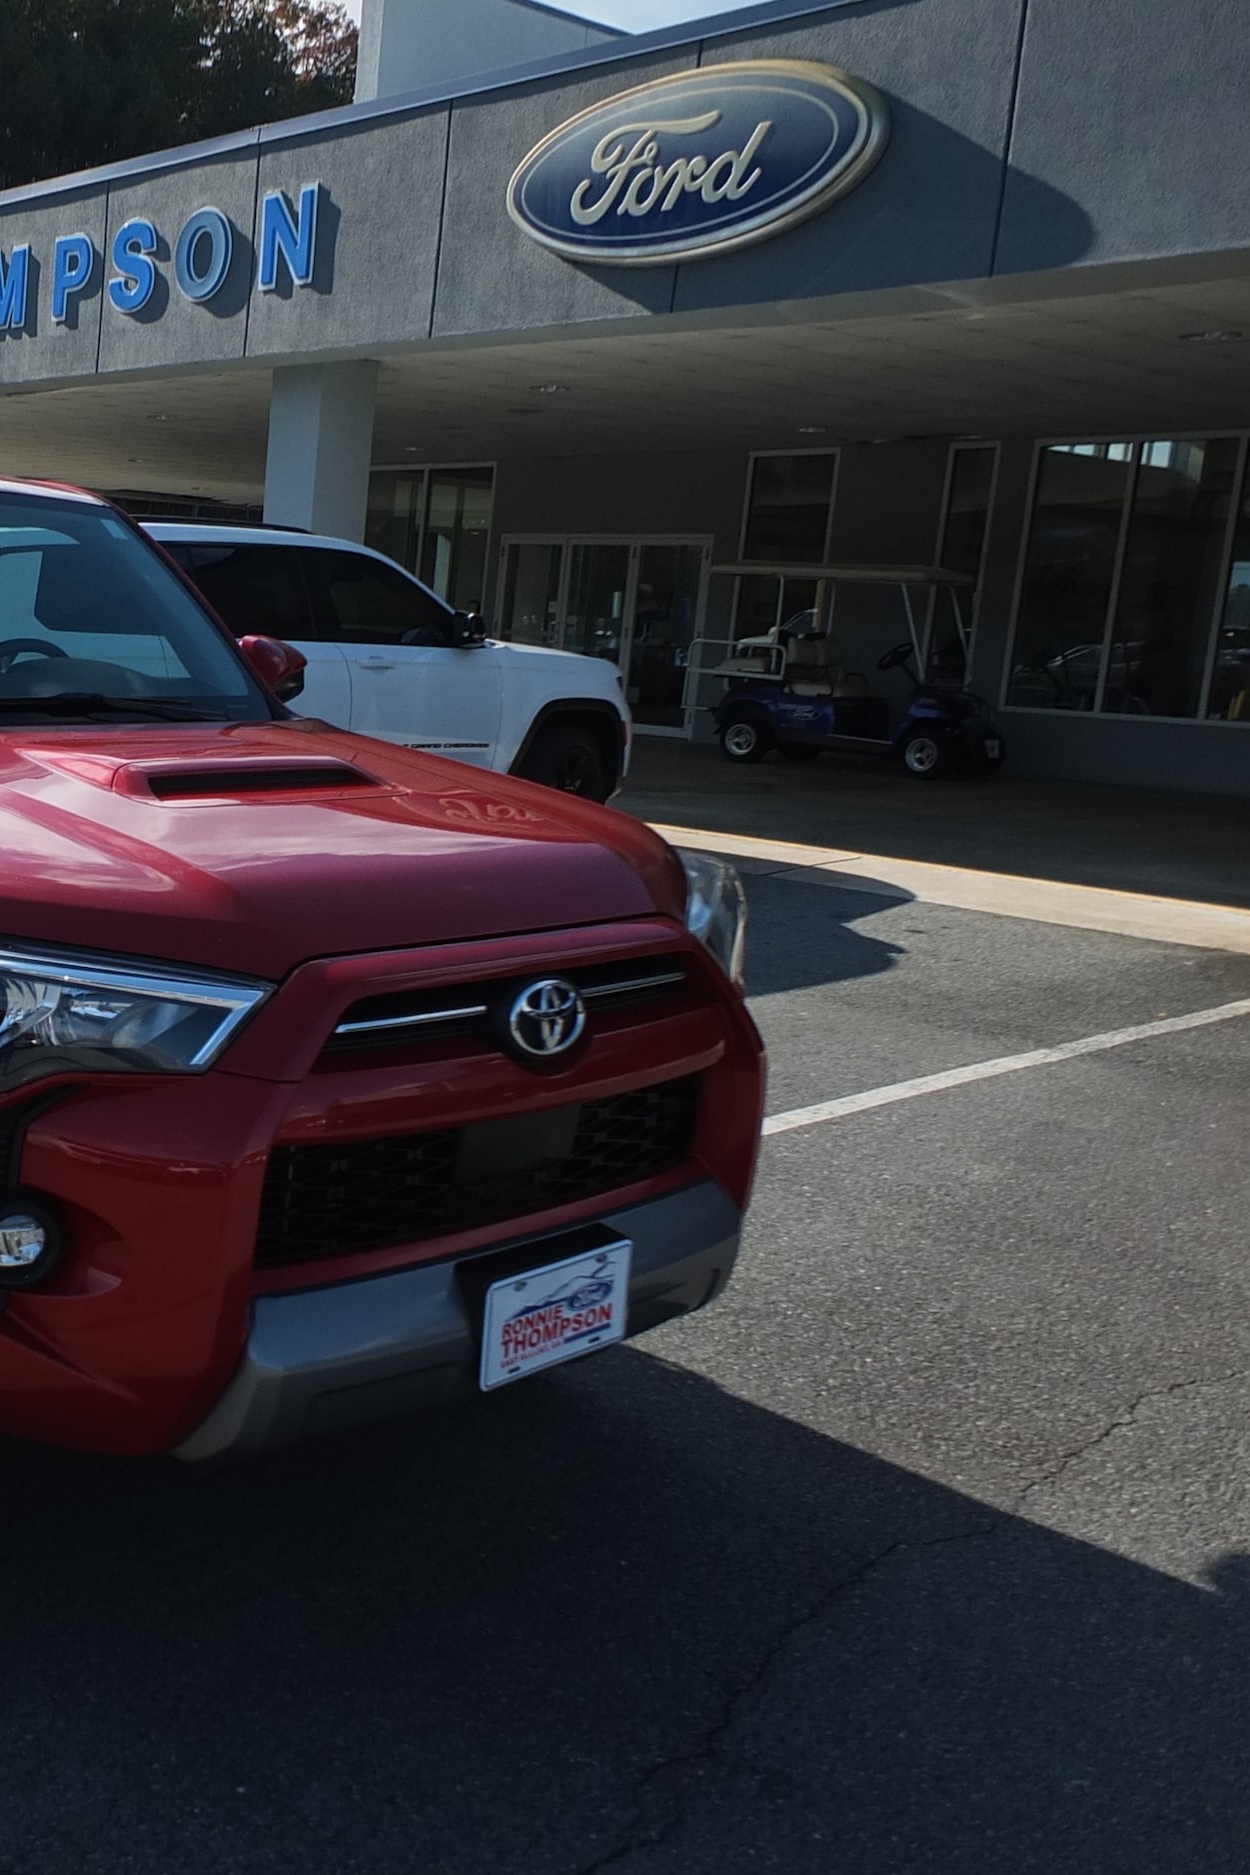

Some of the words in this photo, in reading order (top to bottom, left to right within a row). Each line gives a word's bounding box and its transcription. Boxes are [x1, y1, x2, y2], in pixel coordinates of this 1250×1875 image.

[570, 110, 773, 226] Ford
[501, 1304, 612, 1357] THOMPSON
[502, 1304, 563, 1341] RONNIE
